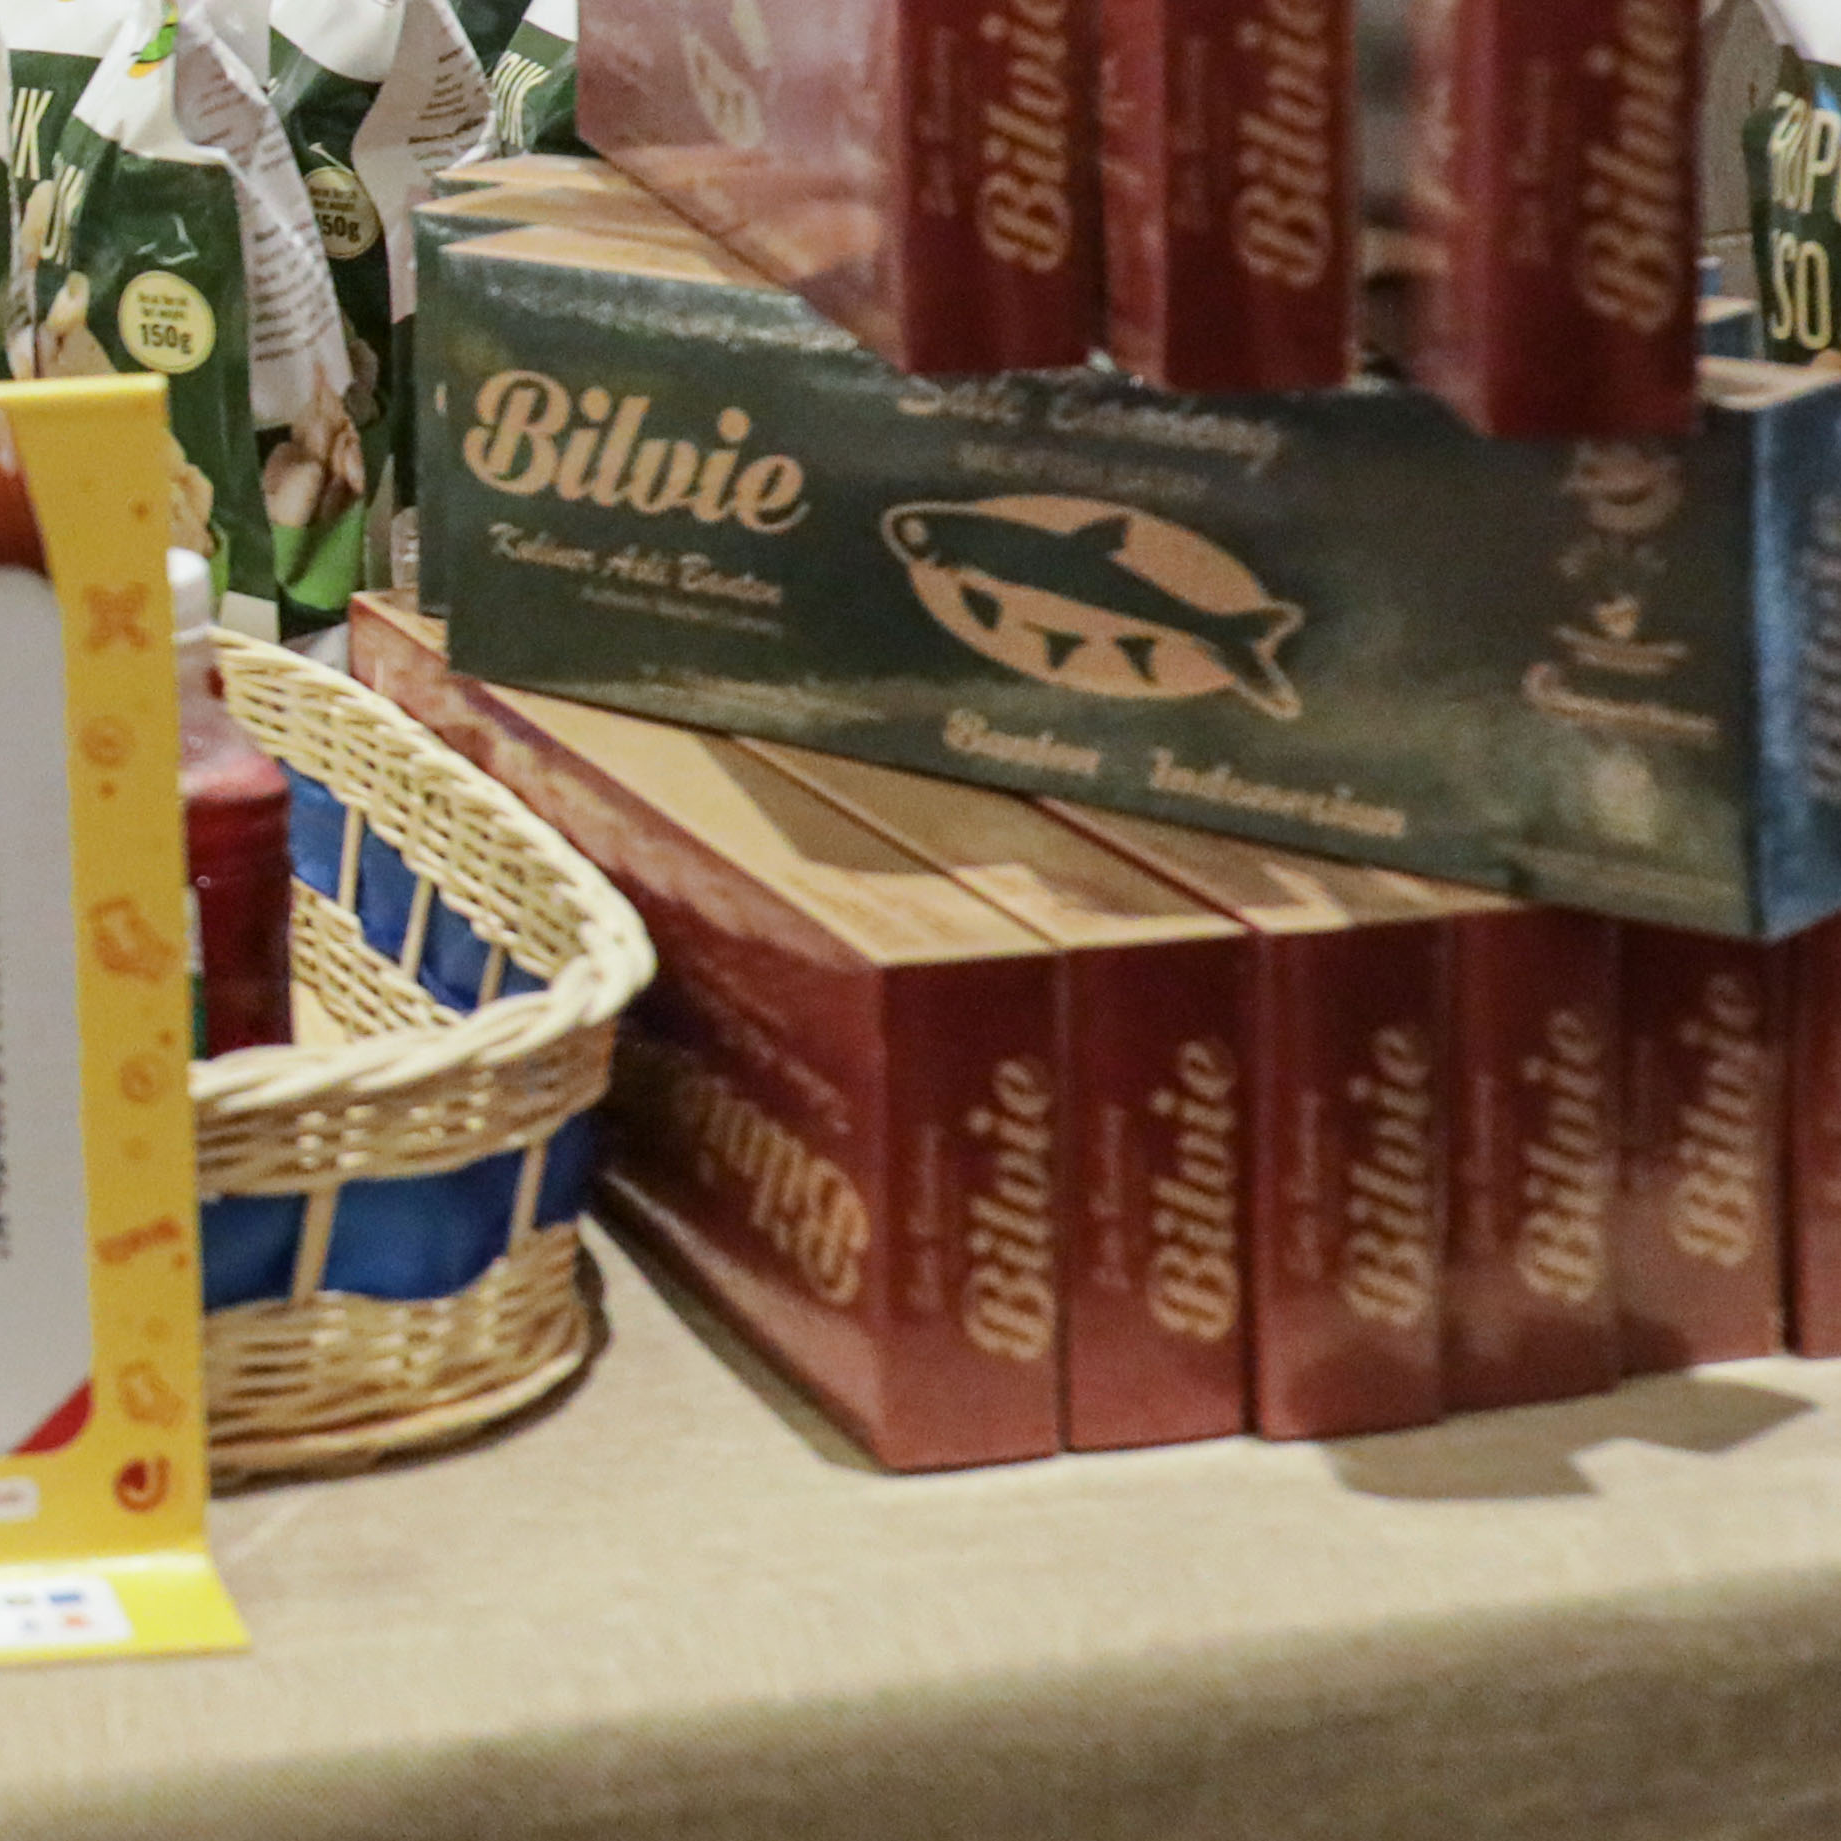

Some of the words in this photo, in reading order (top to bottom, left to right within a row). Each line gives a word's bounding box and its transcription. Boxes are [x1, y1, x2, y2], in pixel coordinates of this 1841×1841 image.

[139, 323, 193, 356] 150g
[463, 369, 810, 534] Bilvie
[960, 1059, 1058, 1361] Bilvie
[1147, 1036, 1239, 1343] Bilvie
[1344, 1025, 1432, 1329] Bilvie
[1522, 1008, 1605, 1307] Bilvie
[1669, 972, 1759, 1266] Bilvie
